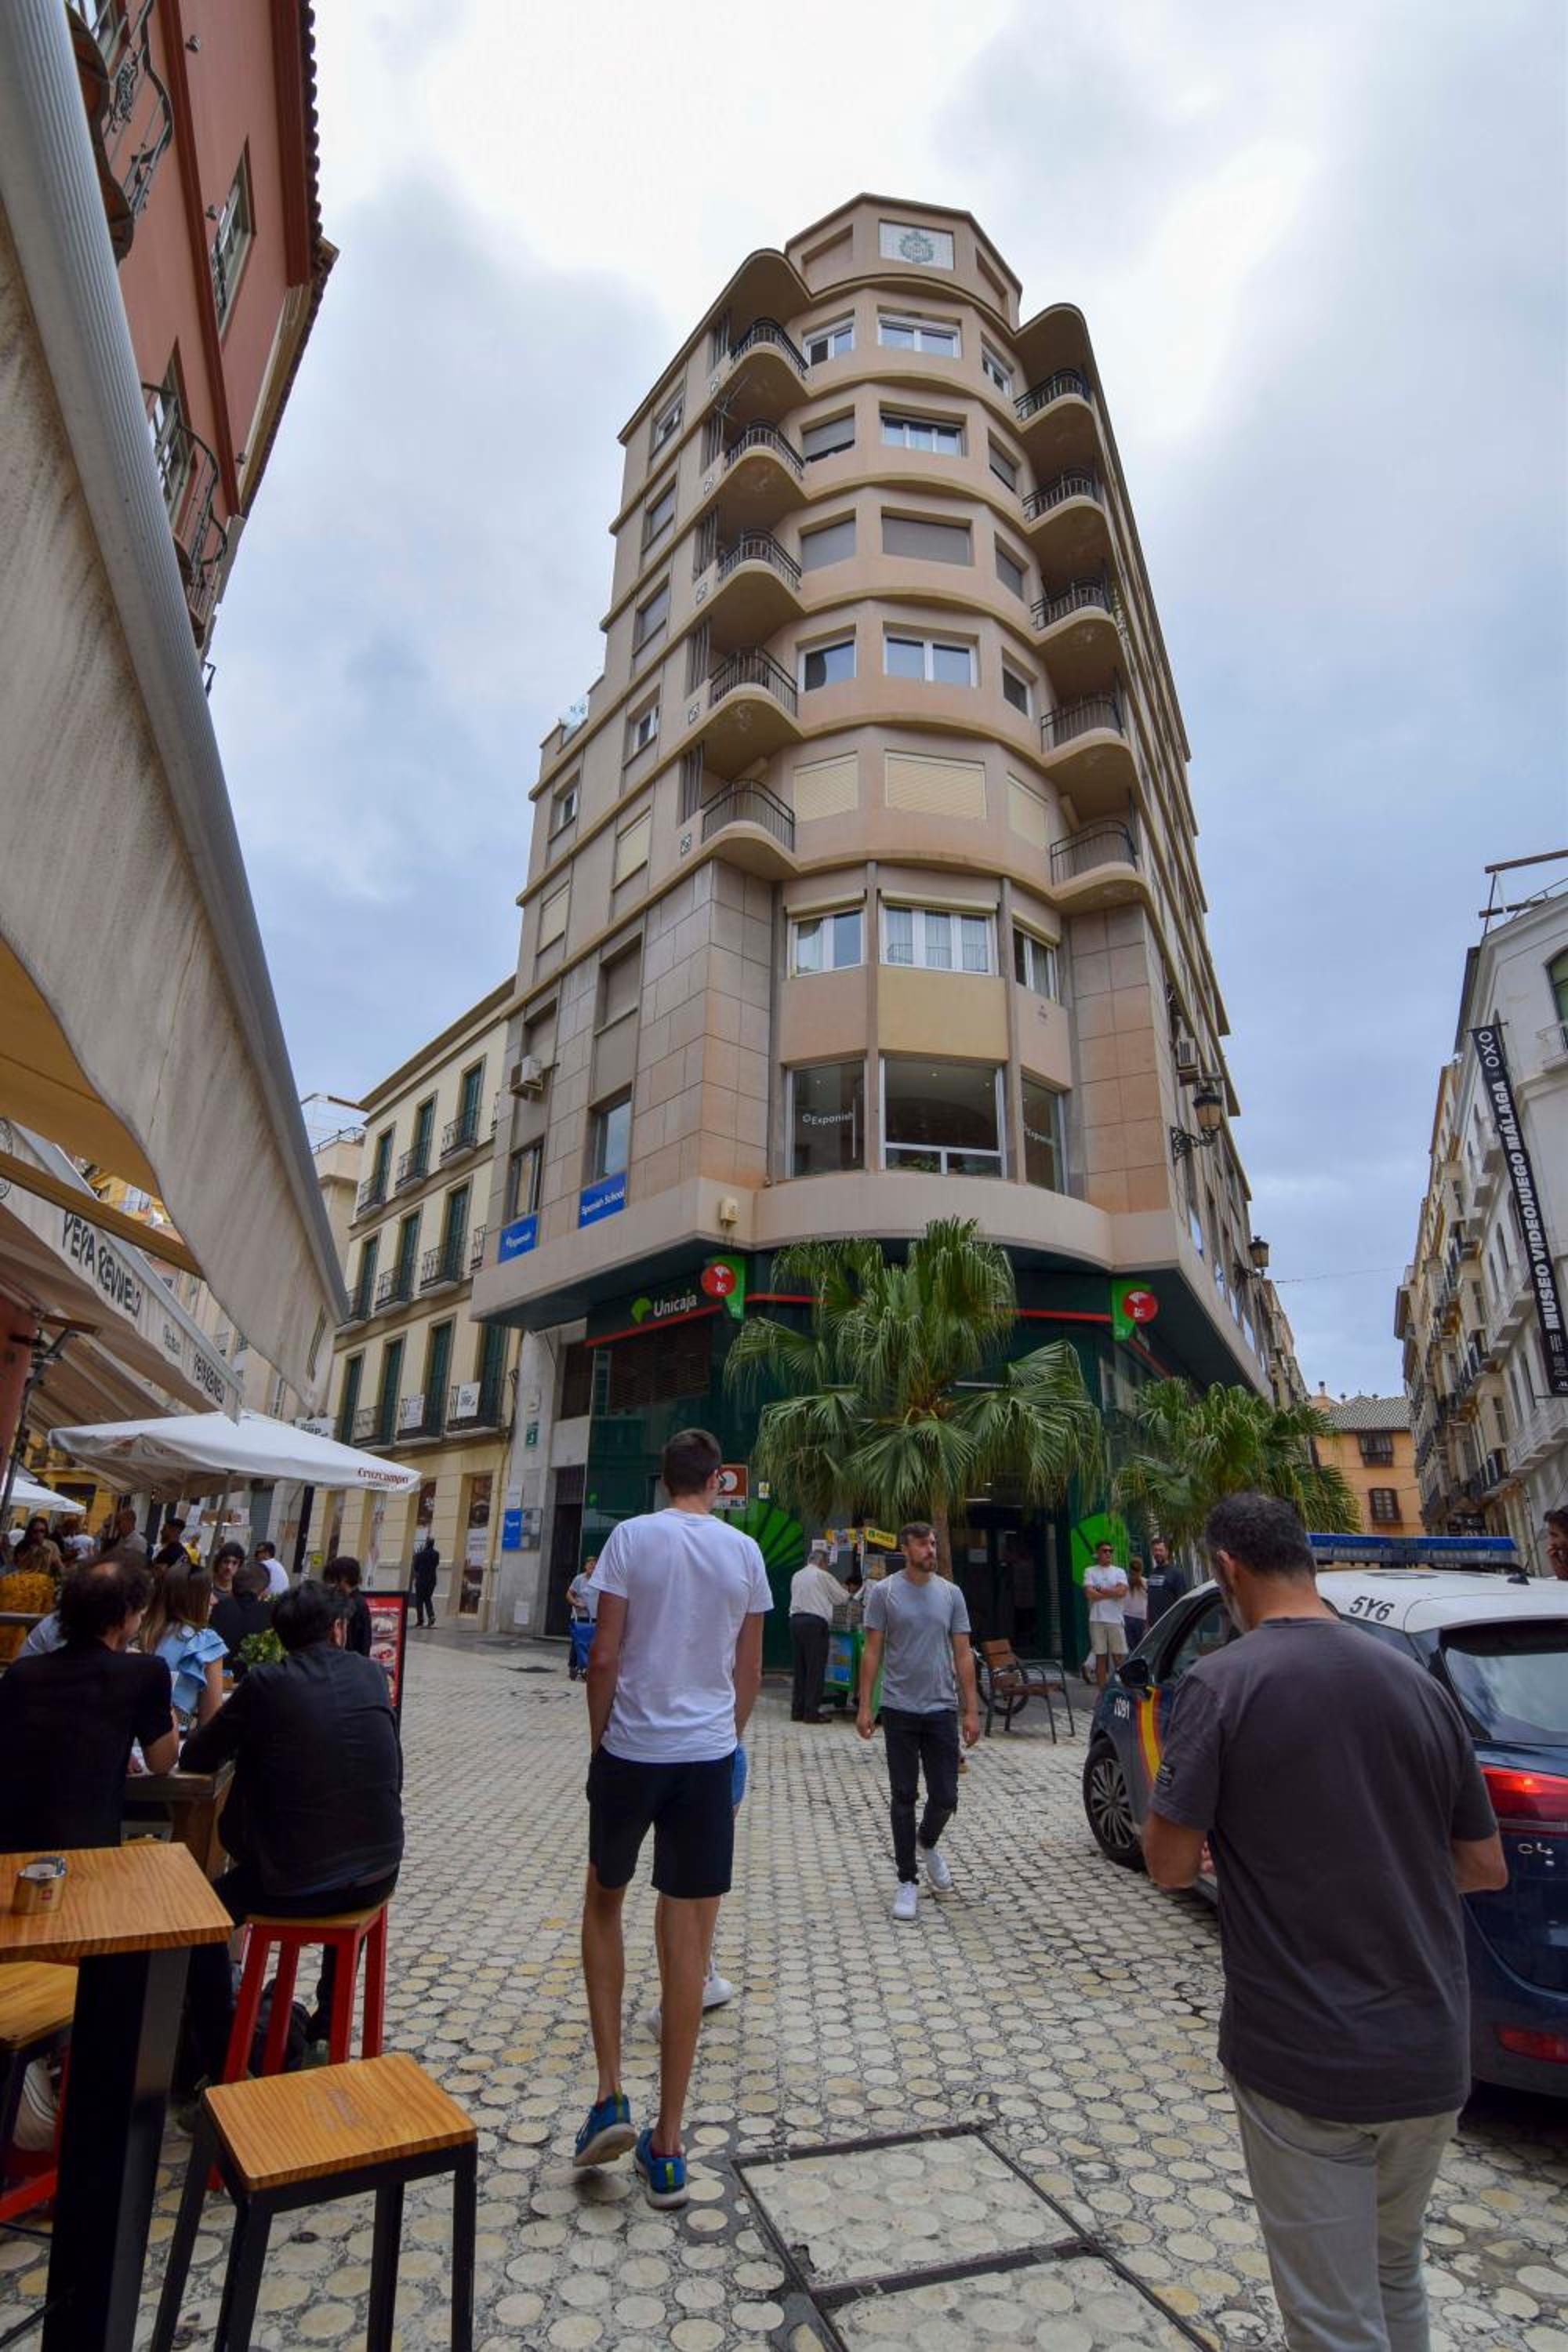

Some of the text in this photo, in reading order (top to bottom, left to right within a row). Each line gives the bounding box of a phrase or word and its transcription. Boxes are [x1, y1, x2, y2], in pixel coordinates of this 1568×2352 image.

[1479, 1031, 1500, 1067] OXO
[1493, 1081, 1522, 1150] MÁLAGA
[1511, 1152, 1546, 1262] VIDEOJUEGO
[653, 1290, 697, 1318] Unicaja
[1535, 1264, 1560, 1329] MUSEO
[1349, 1595, 1395, 1621] 5Y6
